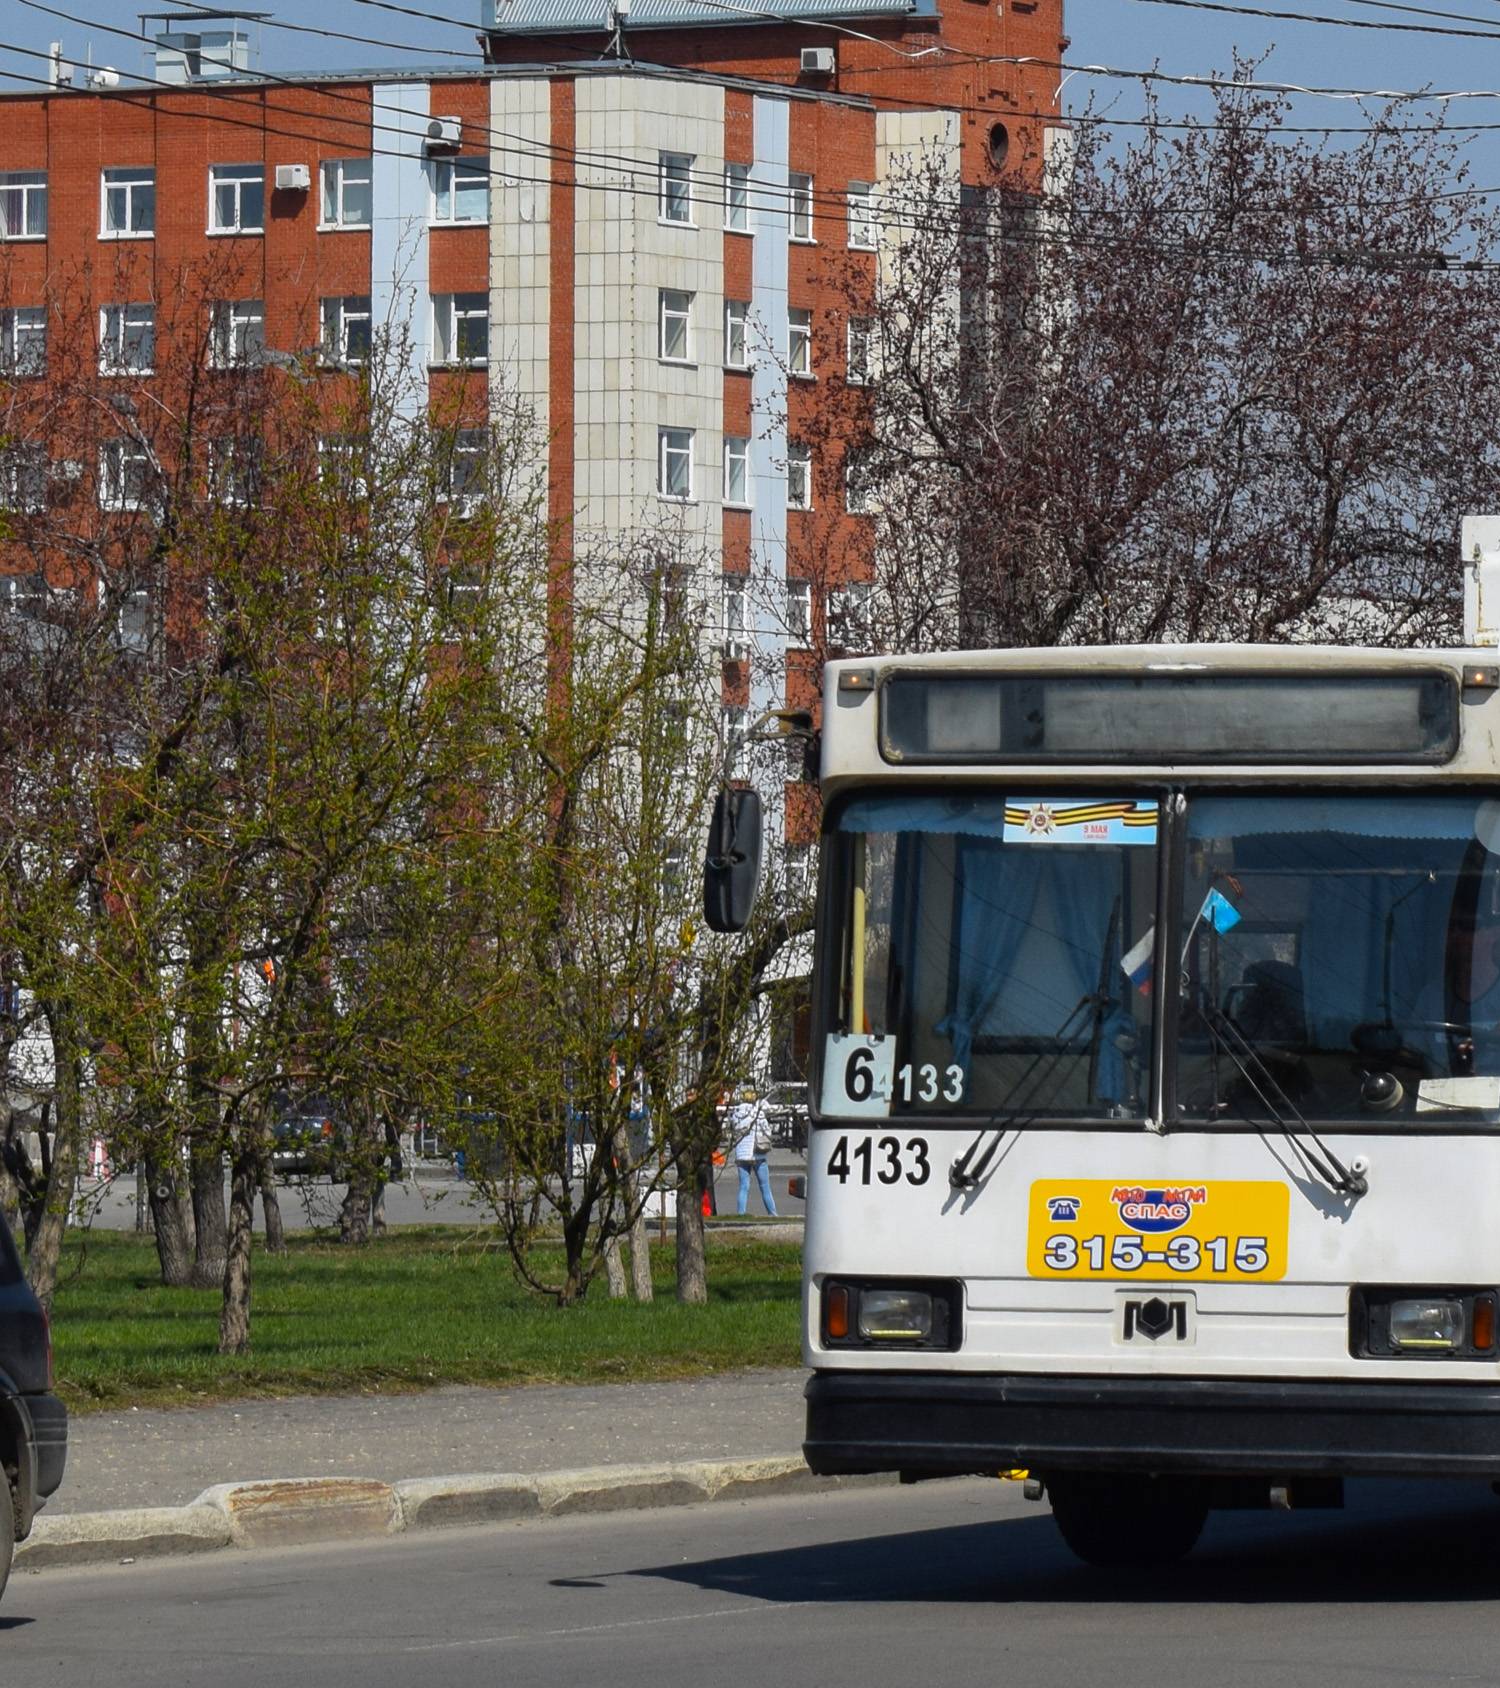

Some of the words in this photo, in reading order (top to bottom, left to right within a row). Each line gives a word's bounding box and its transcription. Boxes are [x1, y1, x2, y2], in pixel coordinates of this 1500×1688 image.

[844, 1047, 875, 1103] 6
[827, 1136, 931, 1186] 4133
[1122, 1203, 1188, 1220] СПАС
[1043, 1234, 1269, 1273] 315-315
